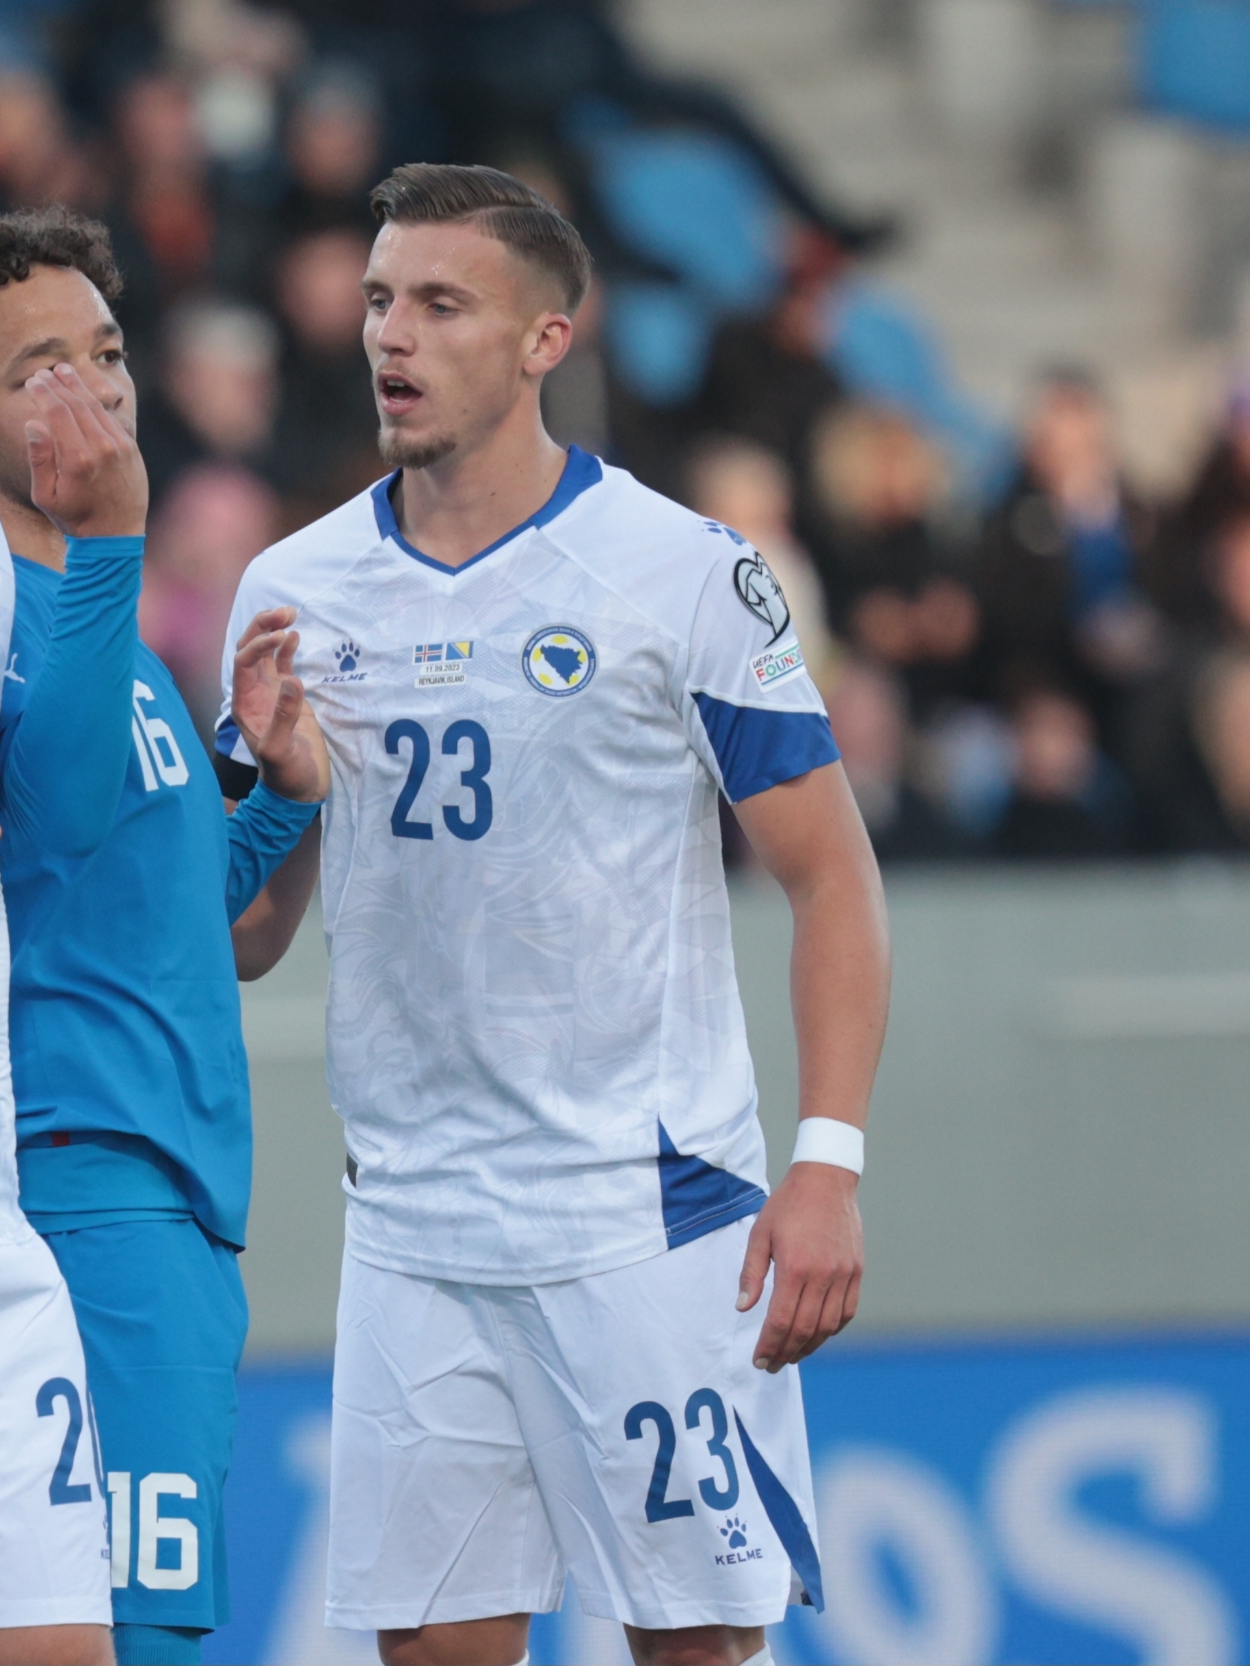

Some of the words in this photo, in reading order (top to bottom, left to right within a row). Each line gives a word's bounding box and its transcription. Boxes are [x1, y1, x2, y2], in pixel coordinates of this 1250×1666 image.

[321, 672, 368, 684] KELME
[425, 663, 460, 673] 11.09.2023
[752, 653, 774, 669] UEFA
[755, 648, 802, 682] FOUND
[132, 679, 190, 792] 16
[384, 718, 493, 841] 23
[35, 1376, 106, 1506] 2
[623, 1387, 739, 1523] 23
[107, 1471, 198, 1590] 16
[715, 1548, 763, 1566] KELME
